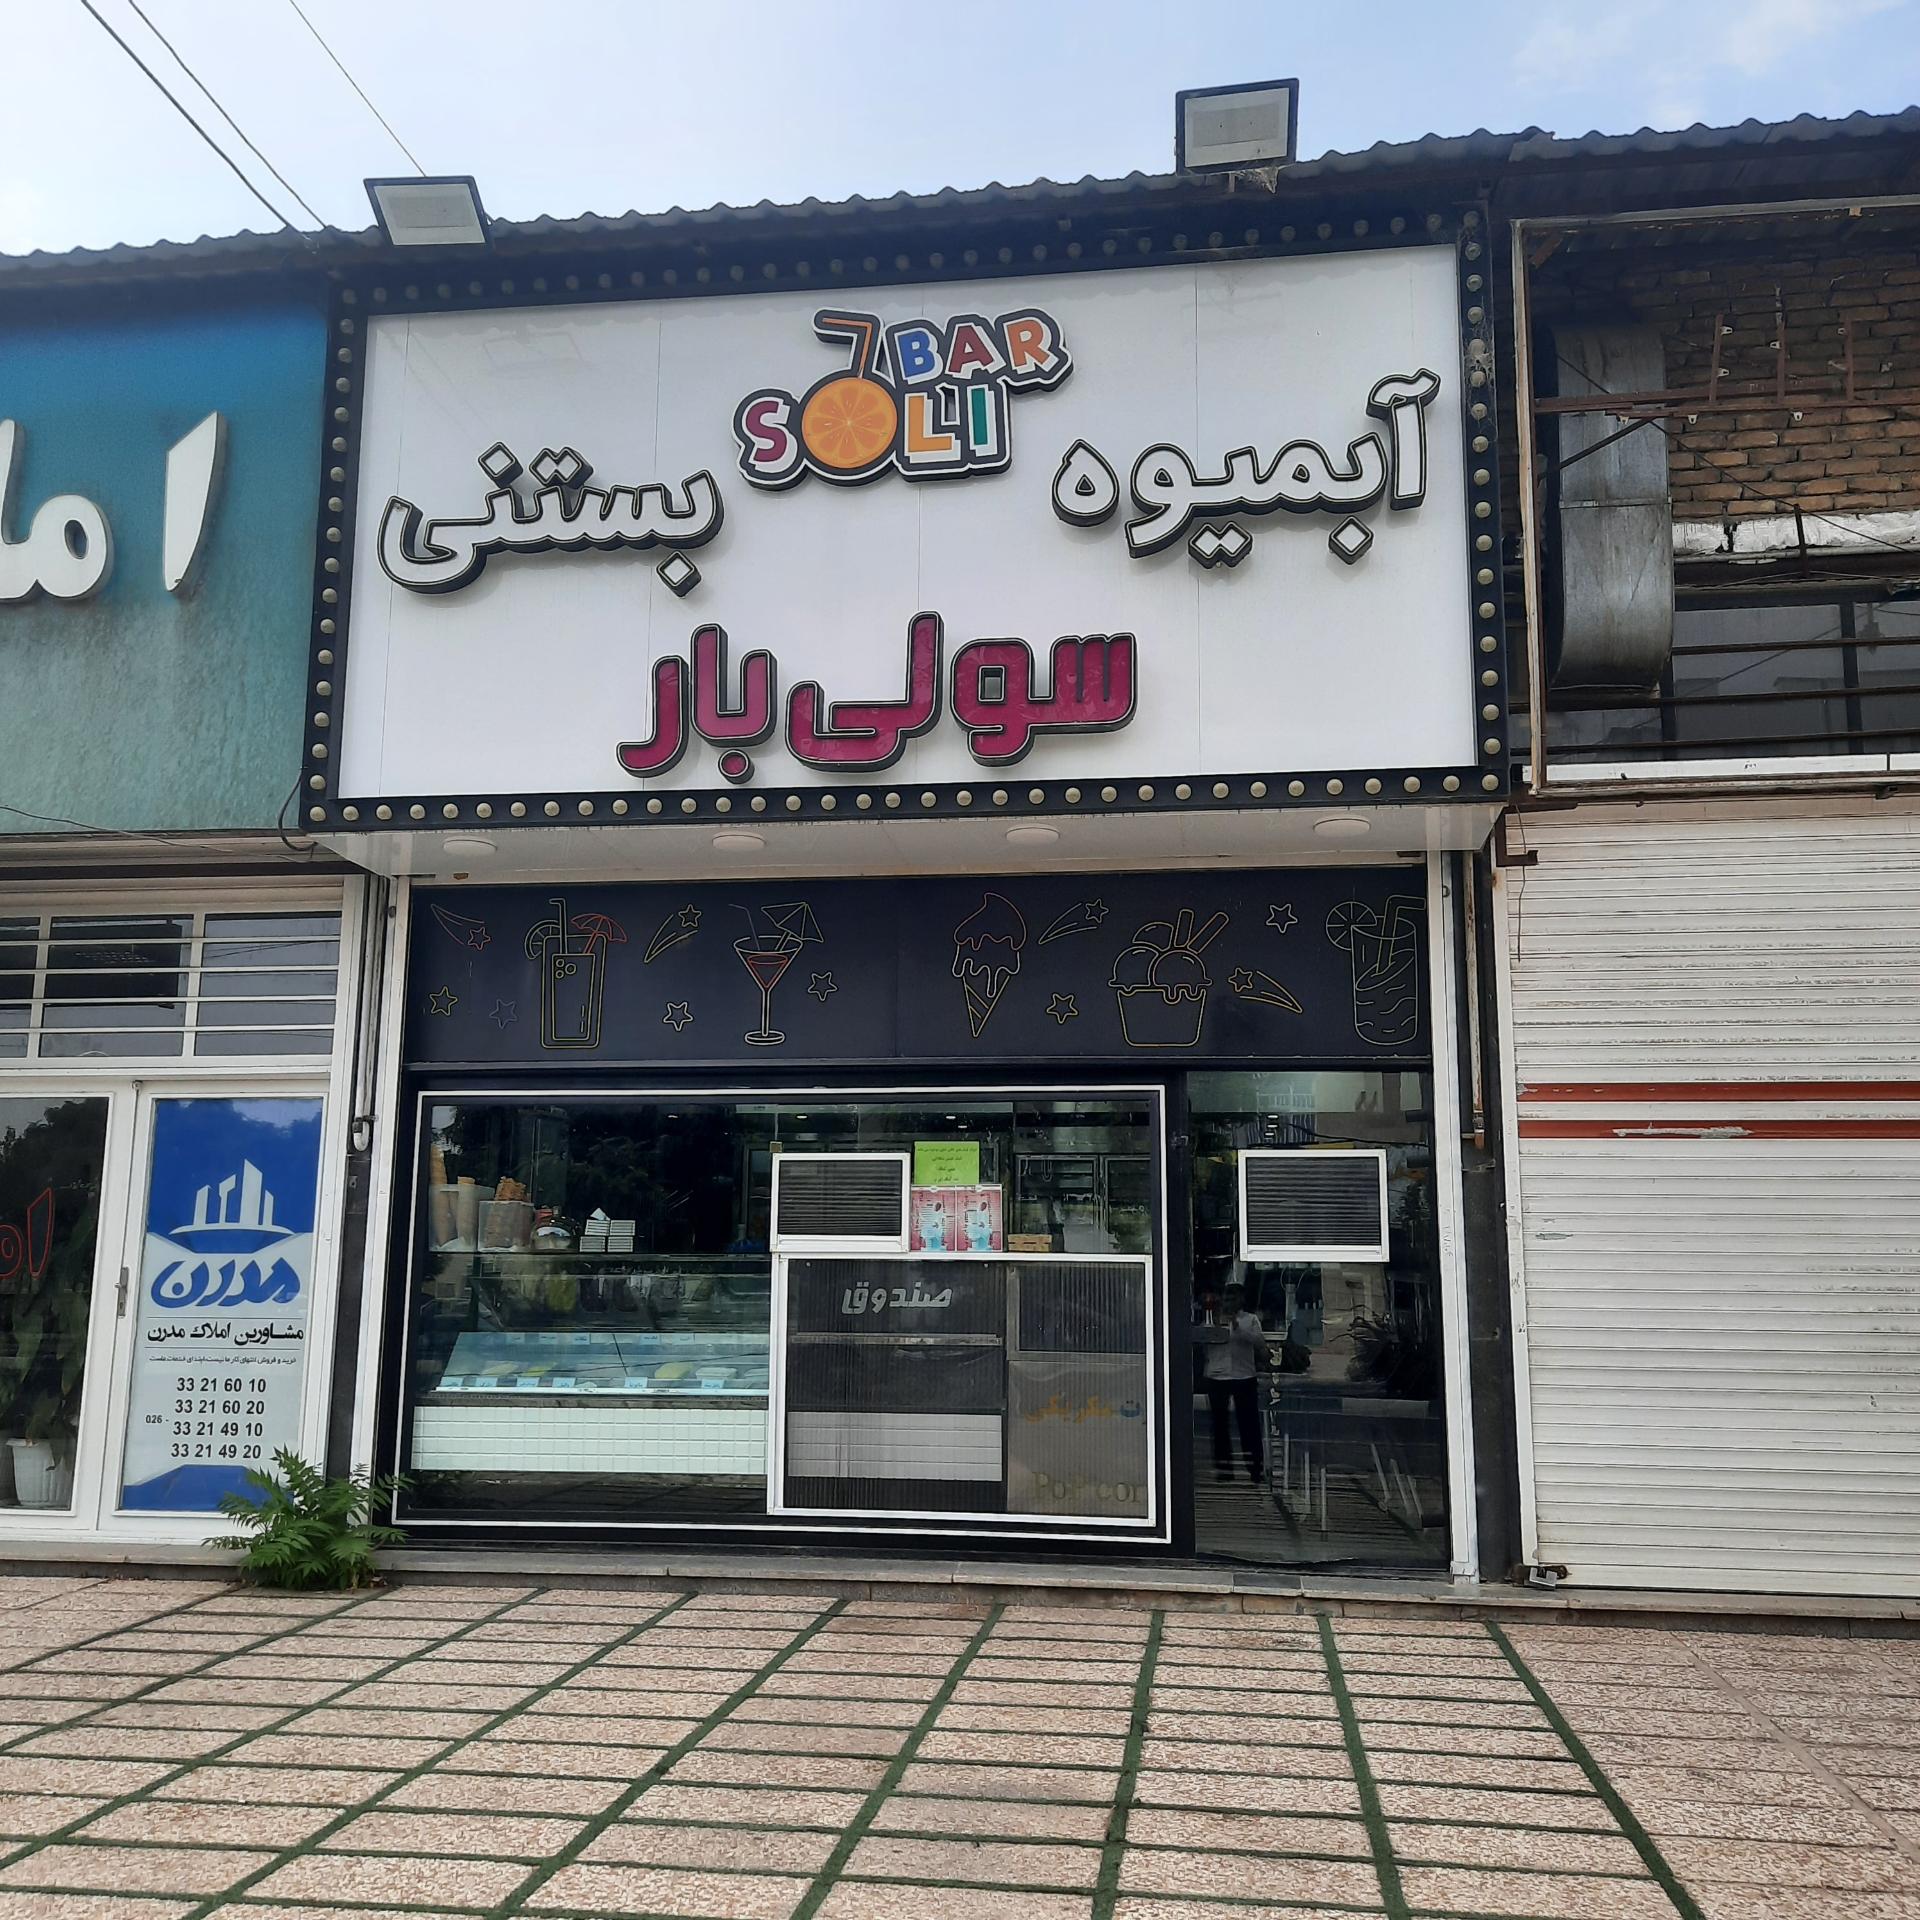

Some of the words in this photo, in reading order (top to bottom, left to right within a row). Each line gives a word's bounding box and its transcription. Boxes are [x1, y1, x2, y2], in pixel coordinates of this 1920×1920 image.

[894, 315, 1060, 387] BAR
[1051, 368, 1441, 569] آبمیوه
[376, 440, 724, 598] بستنی
[616, 622, 778, 785] بار
[786, 610, 1136, 772] سولی
[151, 1257, 300, 1308] مدرن
[841, 1281, 954, 1315] صندوق
[147, 1324, 186, 1342] مدرن
[234, 1322, 303, 1346] مشاورین
[177, 1378, 194, 1391] 33
[200, 1378, 216, 1391] 21
[224, 1378, 242, 1392] 60
[249, 1379, 266, 1392] 10
[175, 1399, 192, 1413] 33
[199, 1400, 215, 1413] 21
[223, 1400, 240, 1414] 60
[246, 1401, 264, 1414] 20
[173, 1421, 190, 1435] 33
[196, 1422, 213, 1435] 21
[221, 1423, 238, 1436] 49
[246, 1423, 263, 1436] 10
[171, 1443, 189, 1457] 33
[195, 1444, 211, 1457] 21
[219, 1444, 237, 1458] 49
[243, 1445, 261, 1459] 20
